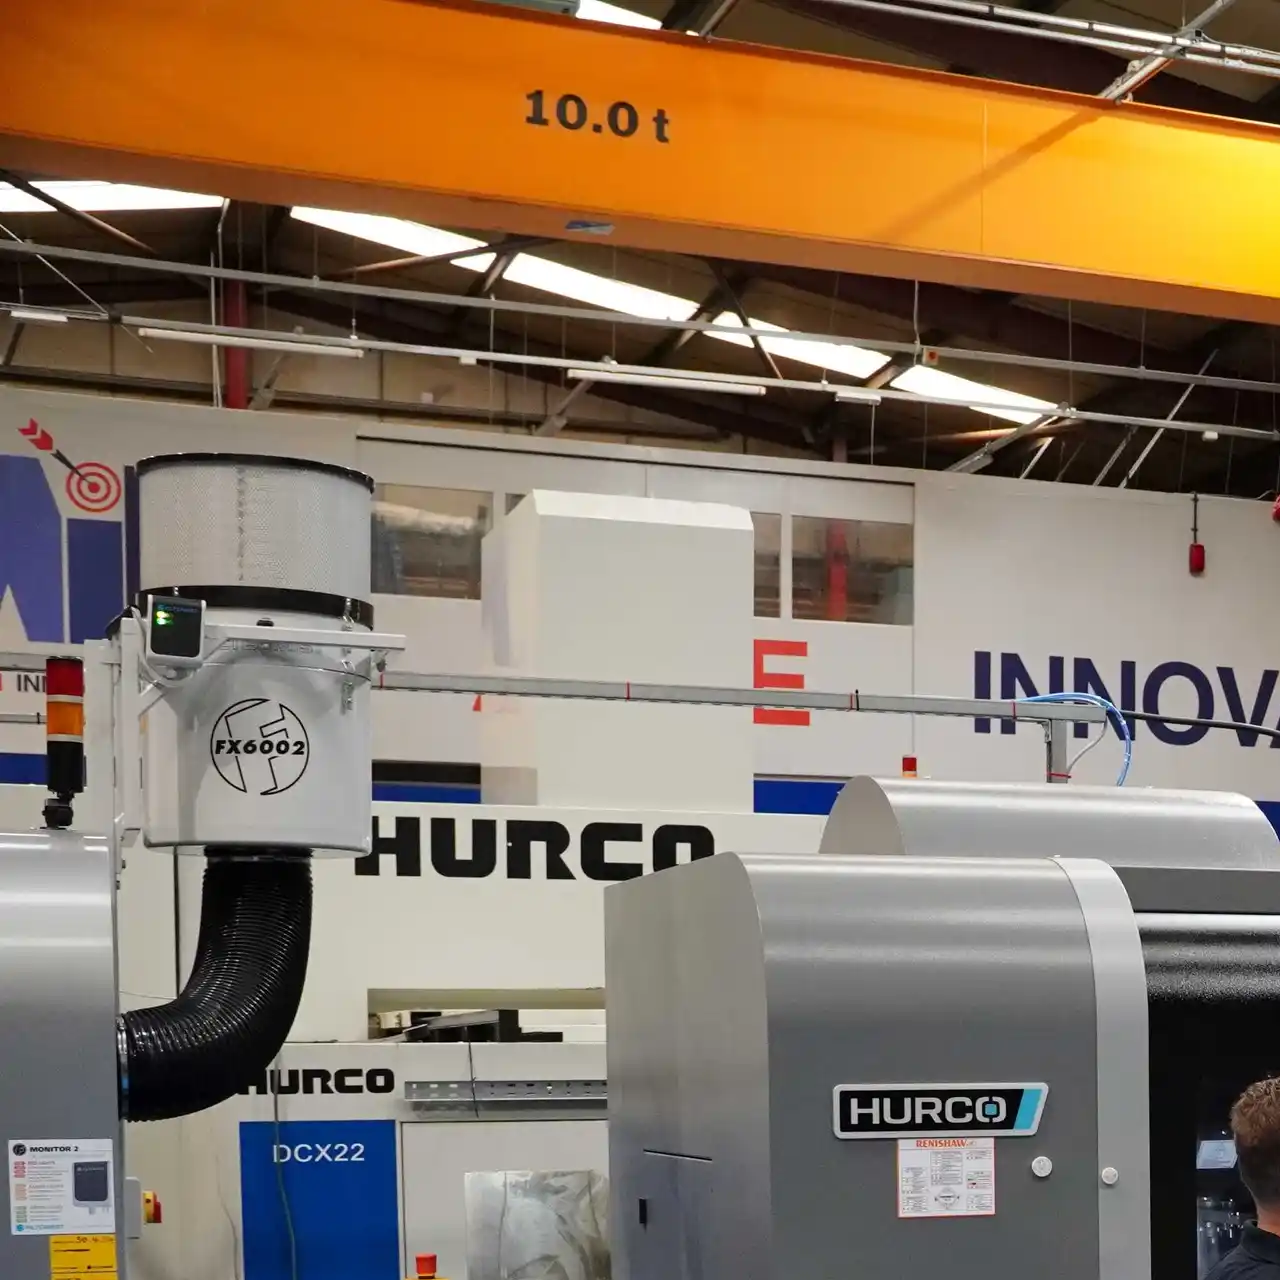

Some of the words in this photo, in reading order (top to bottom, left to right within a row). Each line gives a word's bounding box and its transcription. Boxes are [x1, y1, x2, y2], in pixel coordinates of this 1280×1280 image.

[525, 89, 639, 138] 10.0
[652, 108, 670, 143] t
[214, 737, 305, 756] FX6002
[354, 815, 715, 881] HURCO
[850, 1096, 1007, 1125] HURCO
[273, 1142, 365, 1163] DCX22
[916, 1140, 968, 1148] RENISHAW
